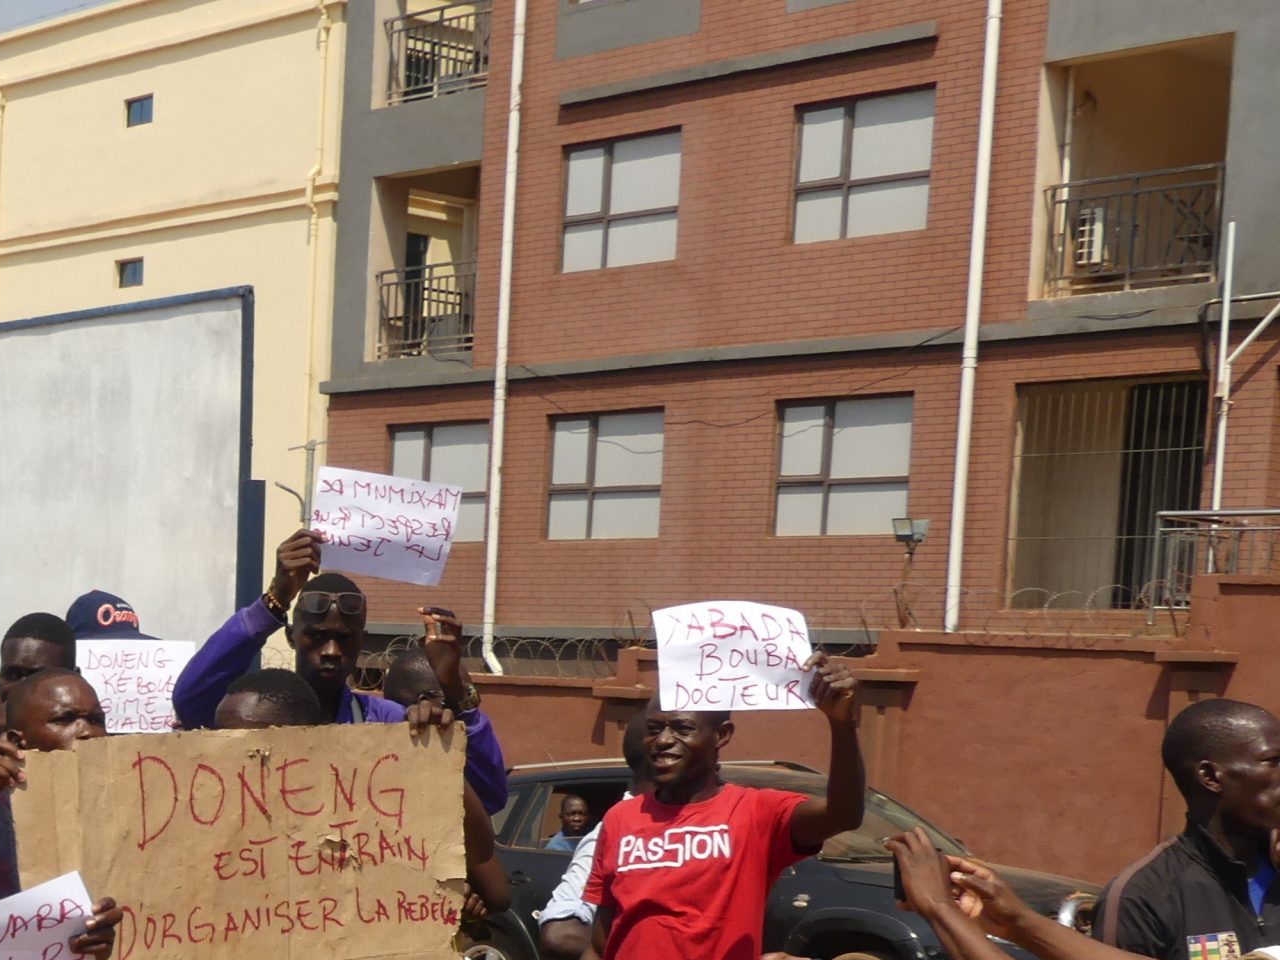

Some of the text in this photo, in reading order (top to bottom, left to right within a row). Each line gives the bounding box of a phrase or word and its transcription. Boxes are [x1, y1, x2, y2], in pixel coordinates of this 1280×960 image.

[86, 648, 175, 670] DONENG
[695, 643, 805, 682] BOUBA
[132, 751, 406, 852] DONENG
[213, 836, 278, 881] EST
[616, 824, 731, 872] PASSION
[355, 888, 390, 924] LA
